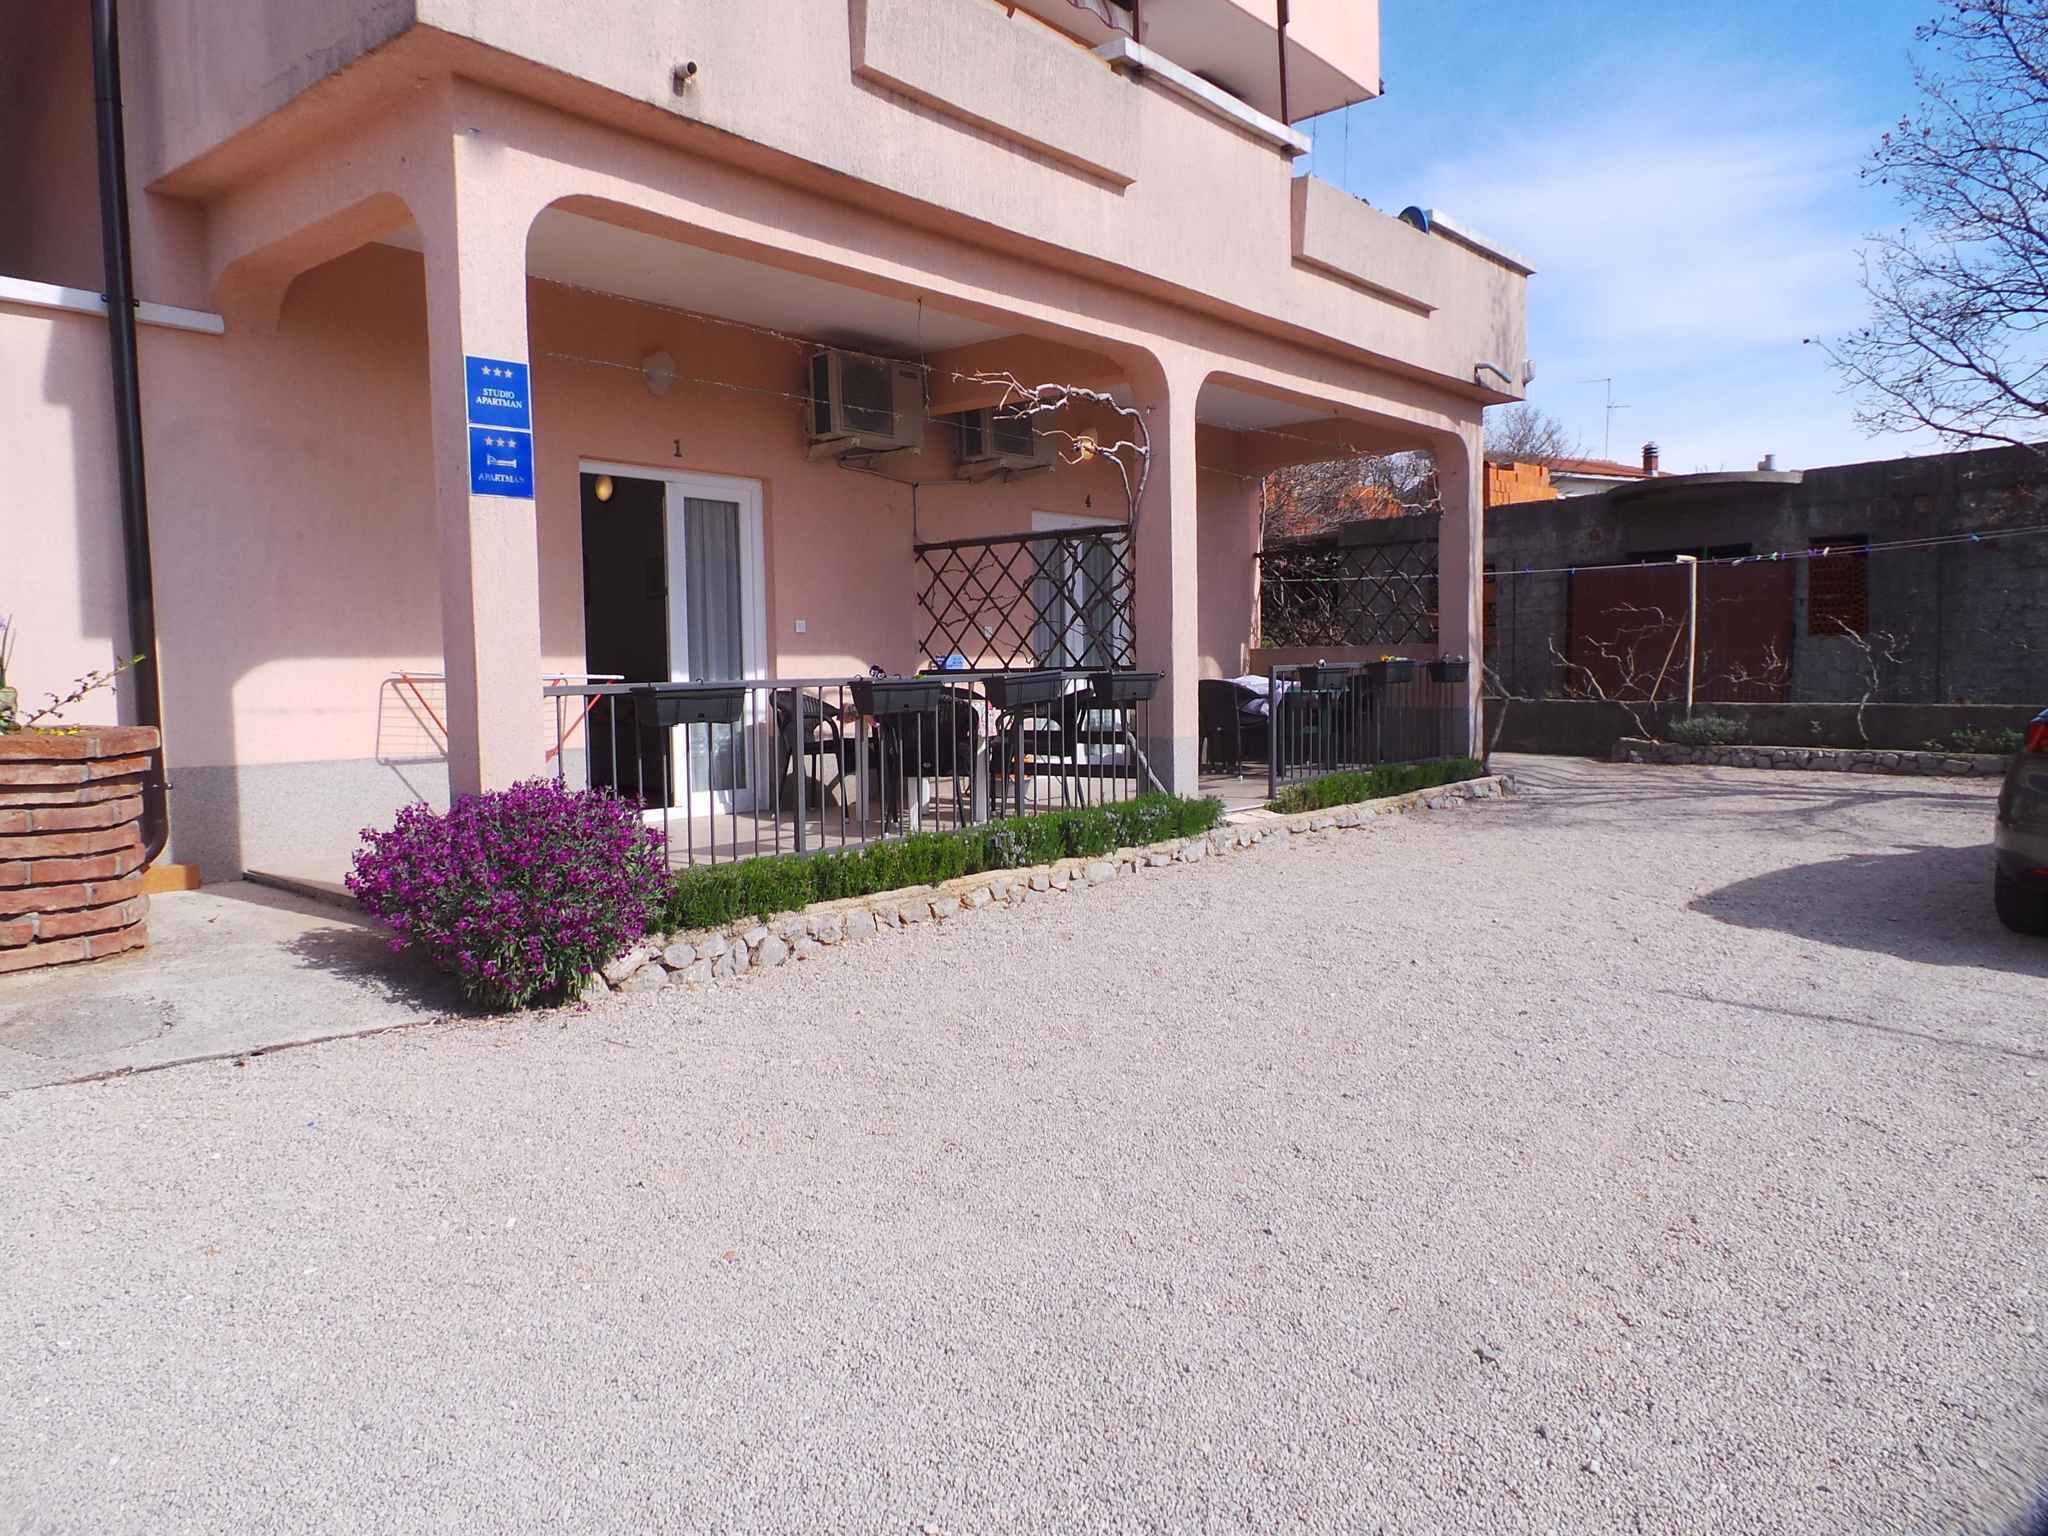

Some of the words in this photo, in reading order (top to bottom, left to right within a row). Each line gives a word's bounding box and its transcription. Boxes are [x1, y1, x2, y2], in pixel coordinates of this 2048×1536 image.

[482, 387, 515, 399] STUDIO
[475, 396, 523, 409] APARTMAN
[673, 435, 684, 457] 1
